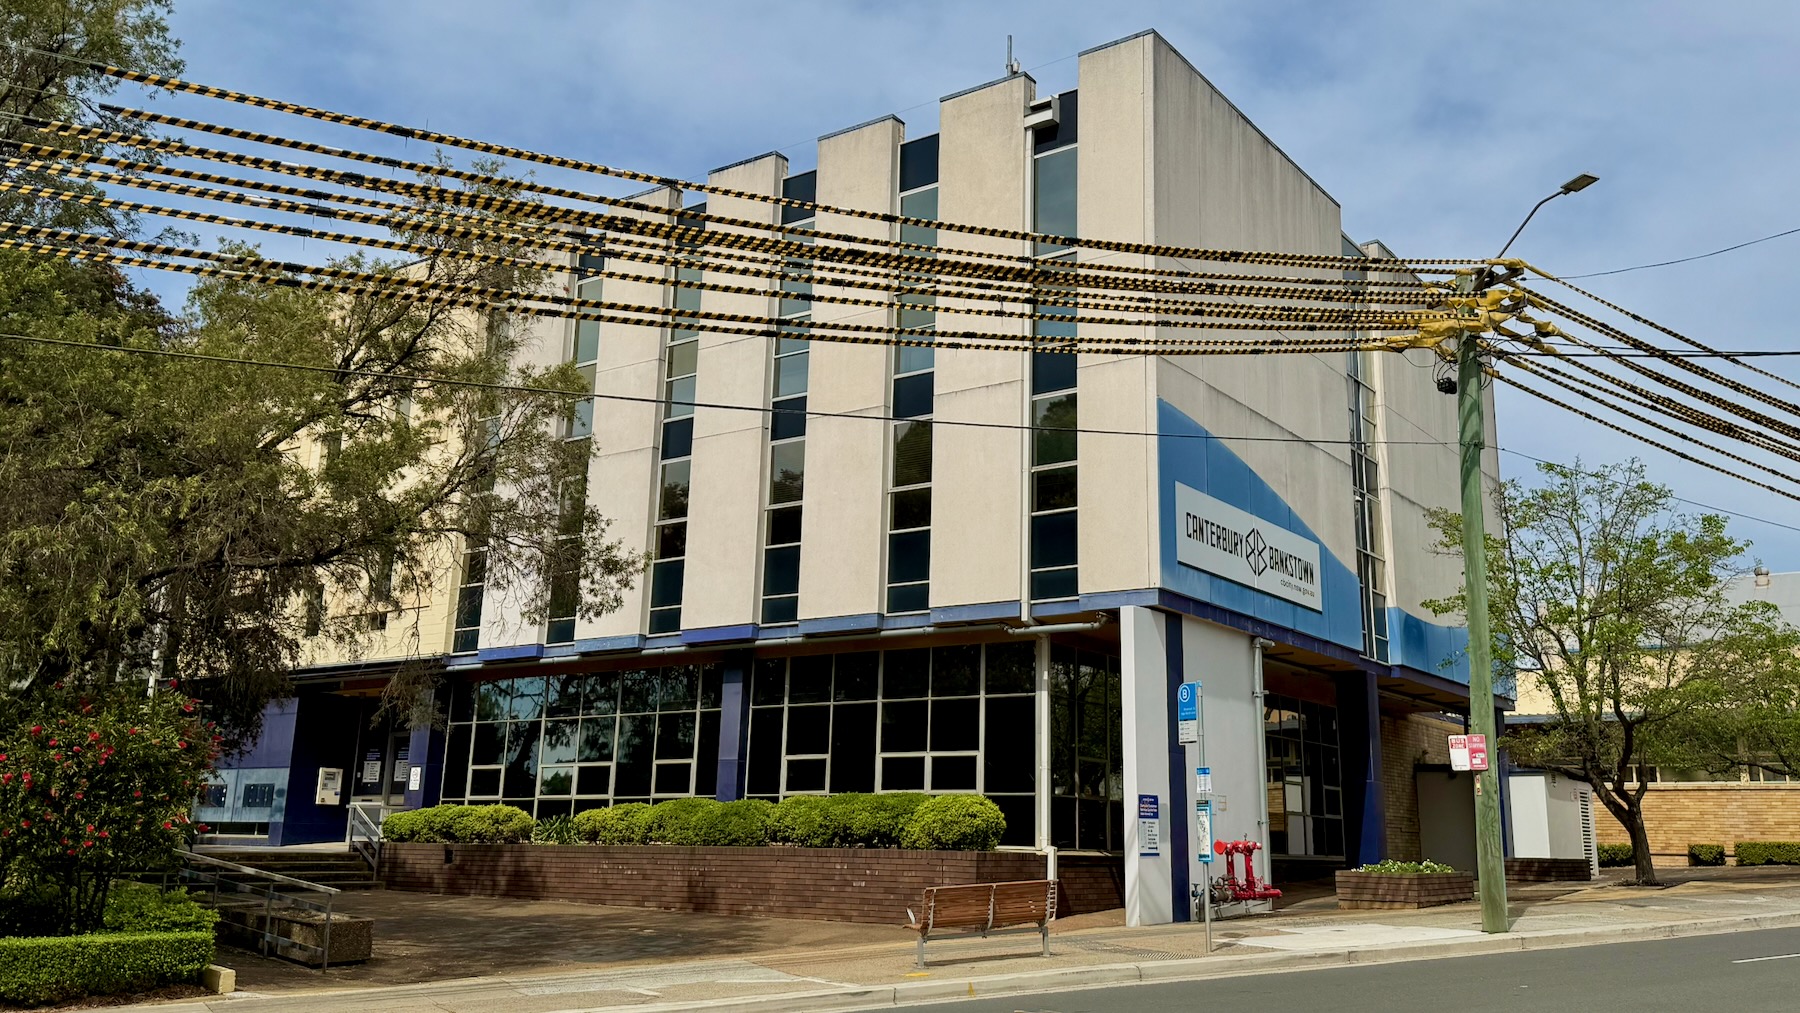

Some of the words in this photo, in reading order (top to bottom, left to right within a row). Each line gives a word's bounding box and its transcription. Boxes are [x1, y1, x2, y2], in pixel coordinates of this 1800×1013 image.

[1185, 512, 1244, 558] CANTERBURY
[1269, 546, 1315, 586] BANKSTOWN
[1280, 578, 1315, 597] cbcity.nsw.gov.au
[1182, 689, 1188, 699] B
